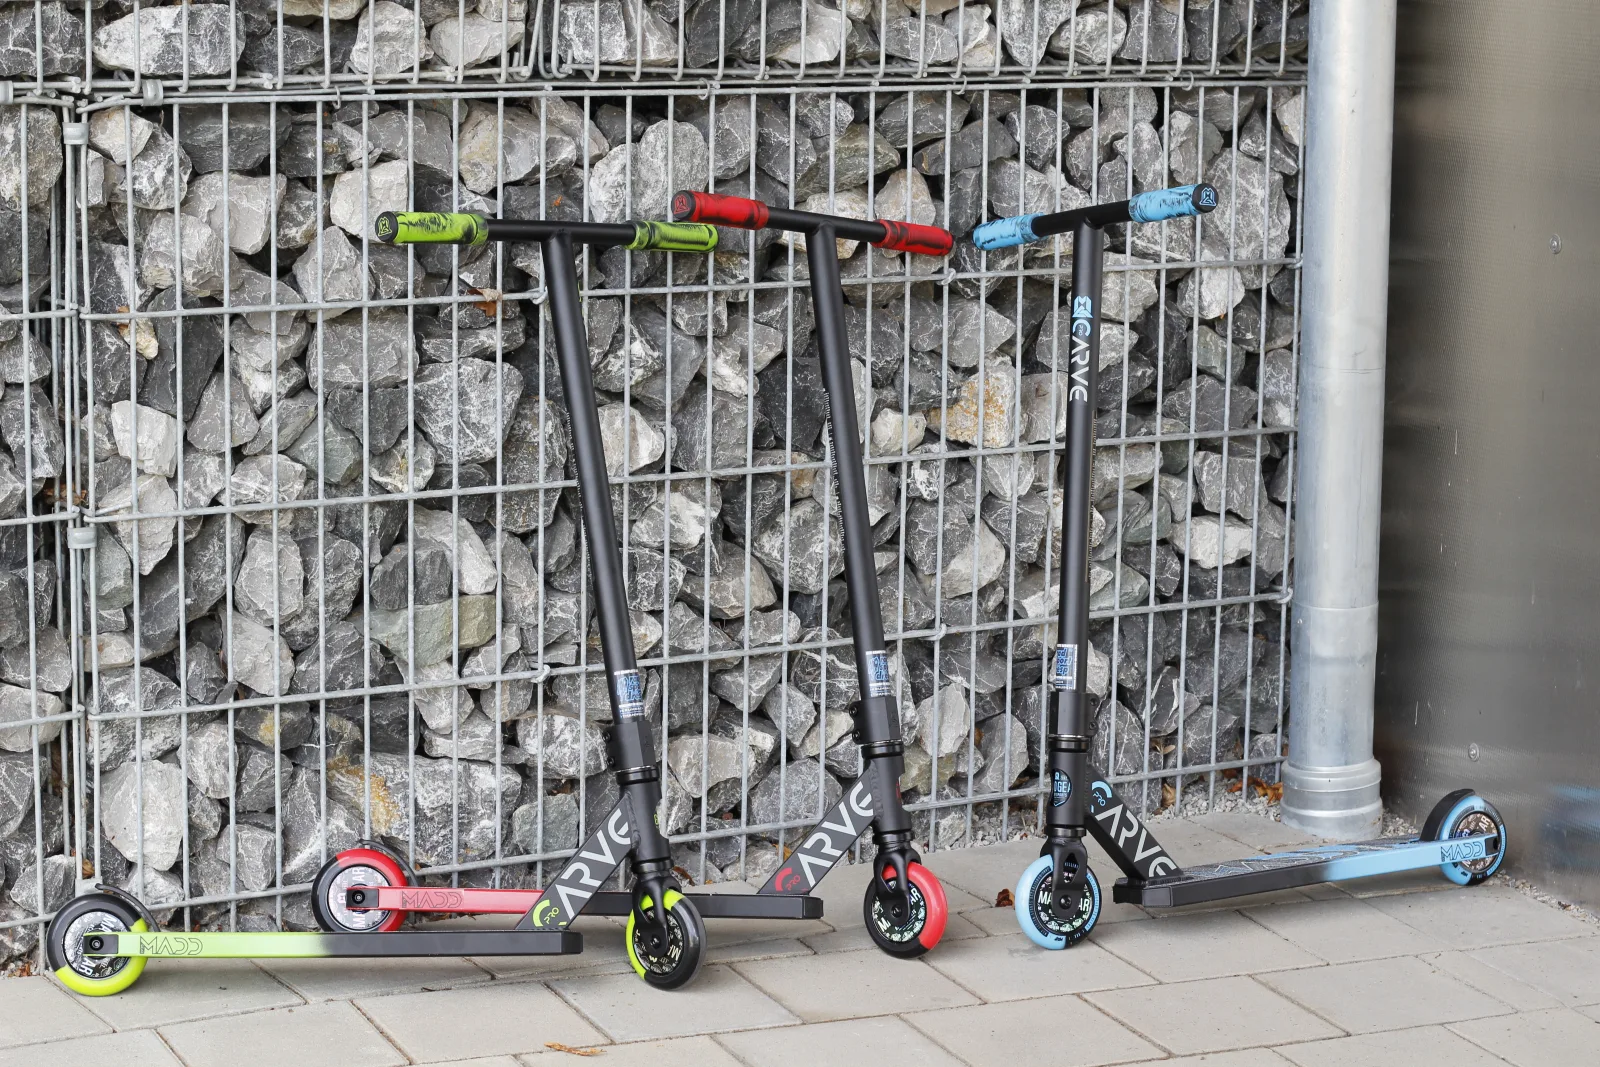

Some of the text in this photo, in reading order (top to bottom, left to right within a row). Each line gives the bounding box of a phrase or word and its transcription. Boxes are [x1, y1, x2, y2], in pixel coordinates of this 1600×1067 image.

[1069, 319, 1091, 402] CARVE
[1440, 841, 1484, 862] MADD
[401, 890, 464, 908] MADD
[543, 907, 560, 924] PRO
[139, 935, 204, 955] MADD
